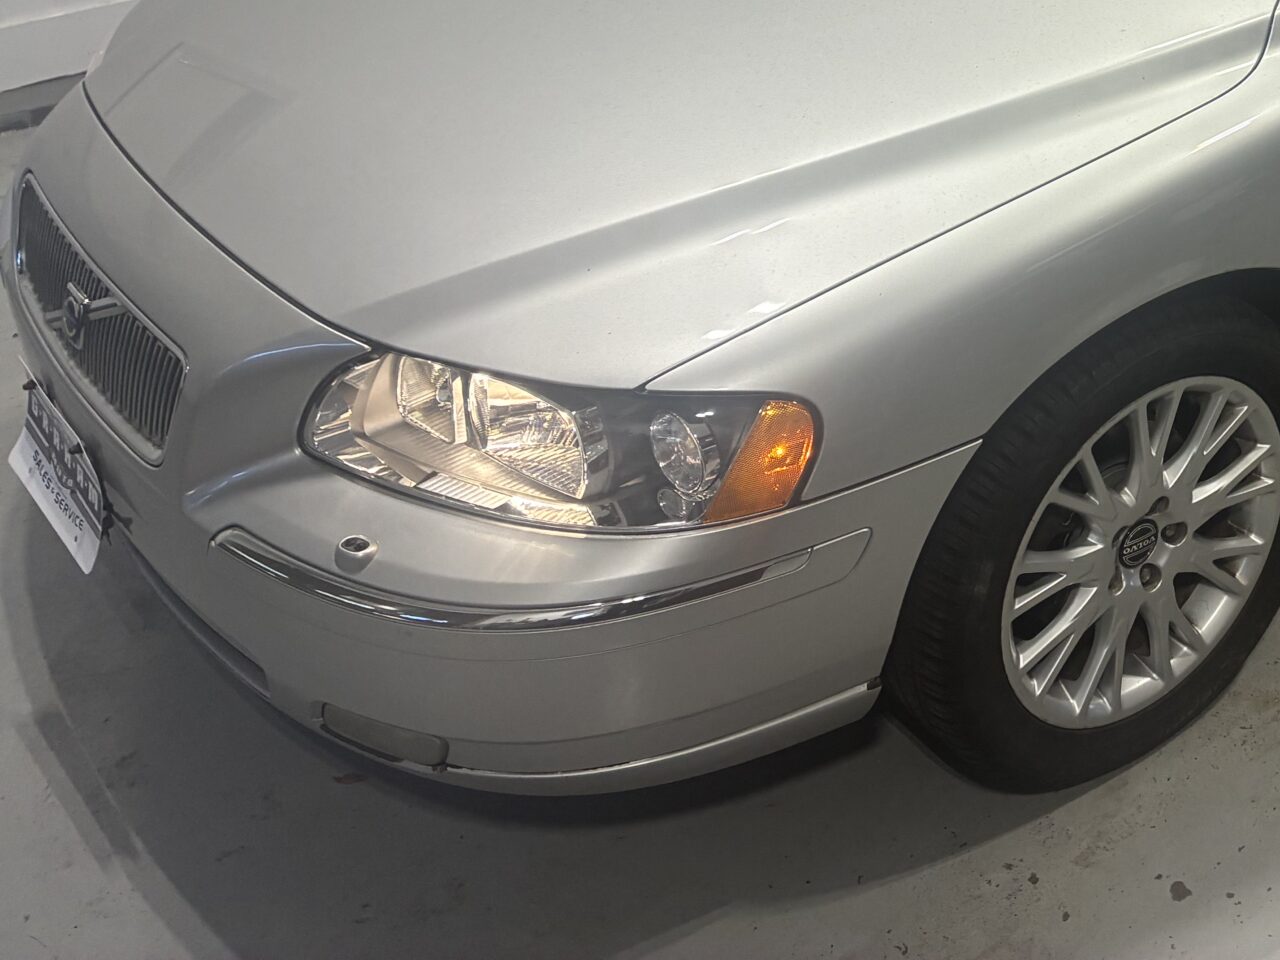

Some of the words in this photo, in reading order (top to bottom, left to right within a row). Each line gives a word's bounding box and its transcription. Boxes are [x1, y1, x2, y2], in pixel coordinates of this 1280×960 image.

[32, 449, 51, 490] SALES
[53, 492, 85, 531] SERVICE
[1122, 534, 1157, 555] VOLVO
